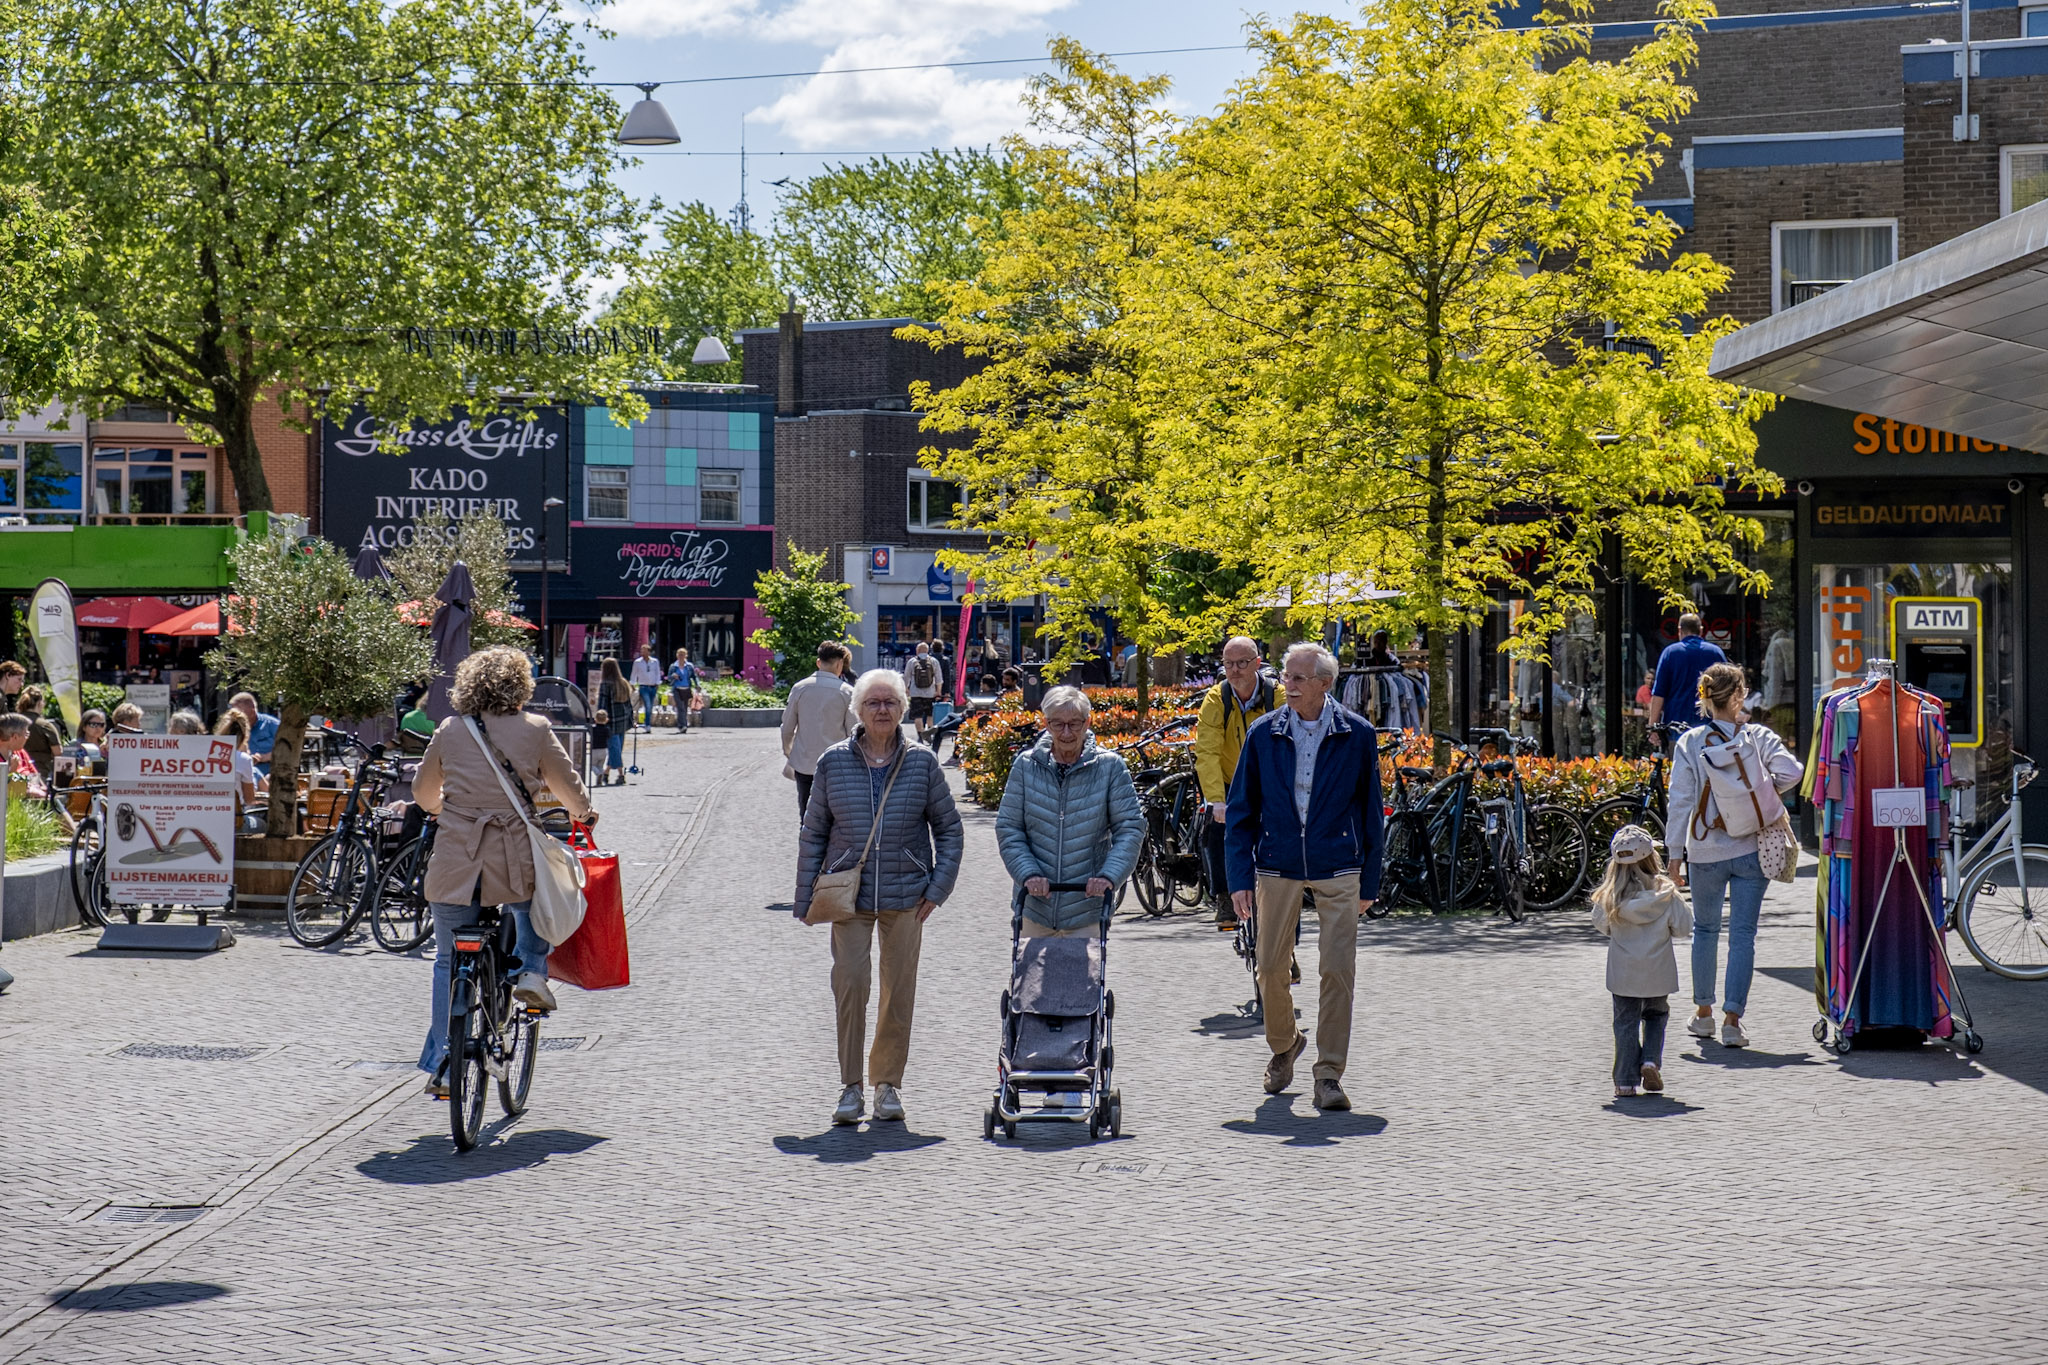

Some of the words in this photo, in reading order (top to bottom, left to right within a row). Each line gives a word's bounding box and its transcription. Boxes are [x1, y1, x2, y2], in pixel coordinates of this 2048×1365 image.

[408, 467, 488, 492] KADO
[1817, 504, 2006, 525] GELDAUTOMAAT
[358, 525, 536, 550] ACCESSES
[621, 543, 682, 558] INGRID's
[617, 548, 728, 597] Parfumbar
[1914, 609, 1963, 627] ATM
[113, 738, 137, 749] FOTO
[140, 738, 179, 750] MEILINK
[140, 758, 233, 774] PASFOTO
[1880, 807, 1919, 824] 50%
[111, 871, 229, 883] LIJSTENMAKERIJ
